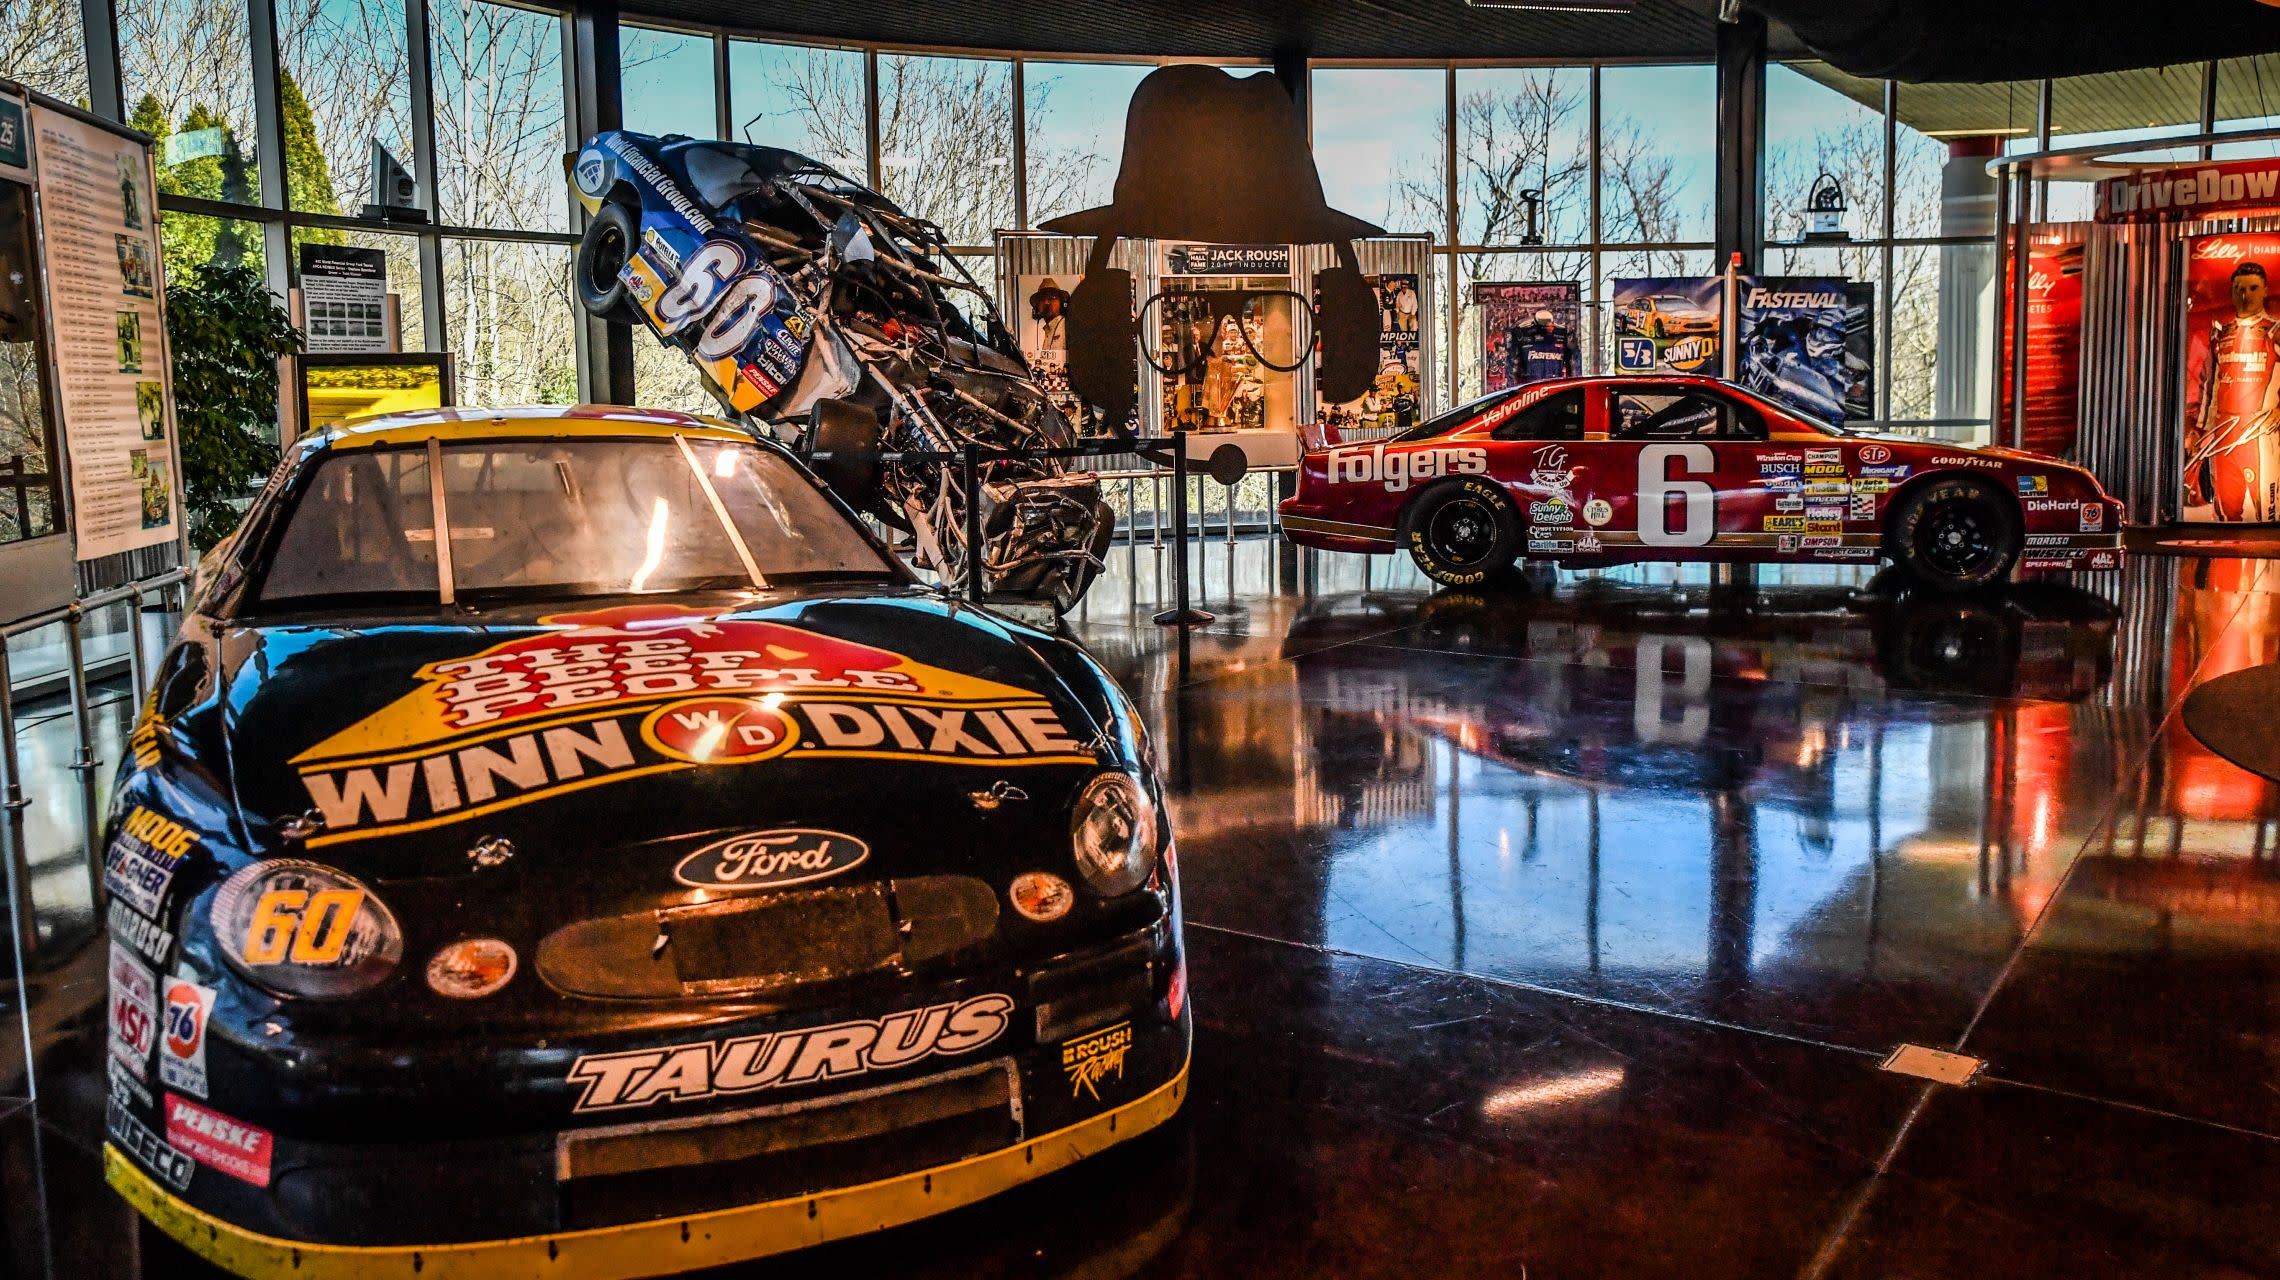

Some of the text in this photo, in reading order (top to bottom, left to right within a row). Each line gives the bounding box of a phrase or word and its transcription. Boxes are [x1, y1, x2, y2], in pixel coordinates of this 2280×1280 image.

[1, 122, 14, 145] 25
[655, 178, 716, 236] Group.com
[1210, 249, 1289, 261] JACK ROUSH
[2191, 238, 2246, 265] Lilly
[655, 239, 777, 361] 60
[1745, 287, 1839, 309] FASTENAL
[776, 330, 801, 357] CLEVITE
[1527, 350, 1564, 361] FASTENAL
[748, 367, 778, 394] PENSKE
[1482, 385, 1549, 427] Valvoline
[1756, 452, 1802, 463] Winston Cup
[1862, 447, 1886, 461] STP
[1931, 455, 2003, 469] GOODYEAR
[1327, 444, 1488, 493] Folgers
[1760, 463, 1801, 474] BUSCH
[1804, 465, 1845, 474] MOOG
[1463, 481, 1506, 511] EAGLE
[1530, 502, 1562, 513] Sunny
[1638, 443, 1716, 547] 6
[2027, 499, 2079, 511] DieHard
[1529, 526, 1574, 534] COMPETITION
[1536, 511, 1573, 522] Delight
[1772, 517, 1805, 527] EARL'S
[1807, 522, 1841, 532] Stant
[1530, 541, 1557, 549] Carlite
[1803, 537, 1839, 546] SIMPSON
[2026, 536, 2070, 546] MOROSO
[2091, 552, 2115, 564] MAC
[436, 637, 693, 680] THE
[441, 650, 762, 703] BEEF
[450, 668, 919, 727] PEOPLE
[301, 718, 636, 830] WINN
[799, 703, 1082, 756] DIXIE
[122, 805, 200, 862] MOOG
[713, 834, 833, 882] Ford
[105, 845, 168, 899] WAGNER
[243, 888, 366, 966] 60
[168, 1005, 194, 1042] 76
[566, 993, 1015, 1115] TAURUS
[1075, 1026, 1132, 1060] ROUSH
[173, 1102, 263, 1154] PENSKE
